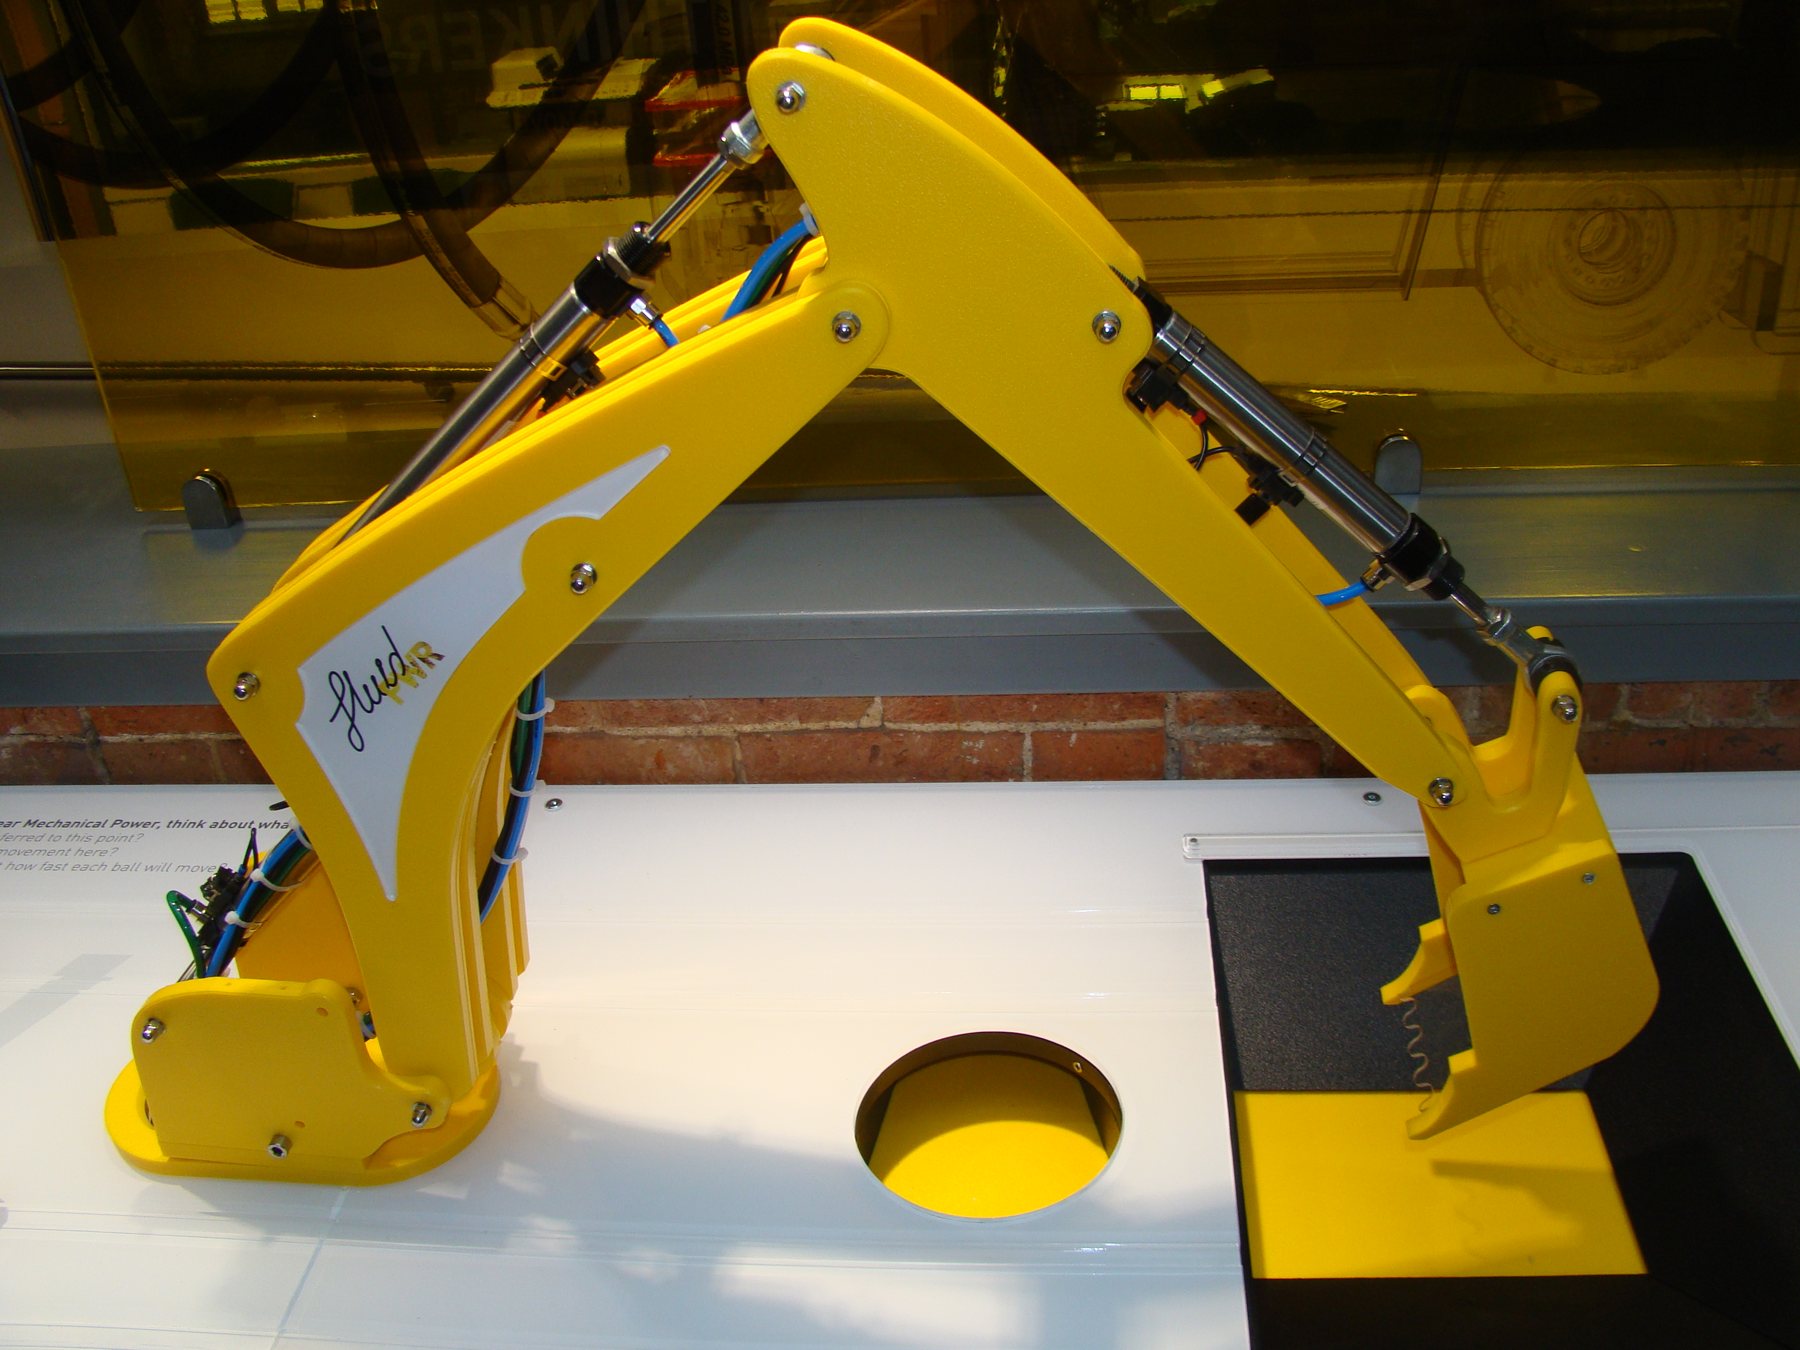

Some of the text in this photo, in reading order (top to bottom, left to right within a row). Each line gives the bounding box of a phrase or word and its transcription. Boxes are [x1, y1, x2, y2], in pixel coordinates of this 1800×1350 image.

[22, 819, 108, 828] Mechanical
[110, 819, 160, 830] Power,
[166, 820, 206, 829] think
[209, 820, 255, 829] about
[258, 820, 290, 830] wha
[47, 833, 62, 842] to
[64, 833, 93, 842] this
[94, 833, 145, 844] point?
[73, 847, 119, 857] here?
[4, 861, 37, 871] how
[39, 861, 68, 872] fast
[71, 862, 108, 872] each
[111, 862, 141, 872] ball
[144, 862, 172, 873] will
